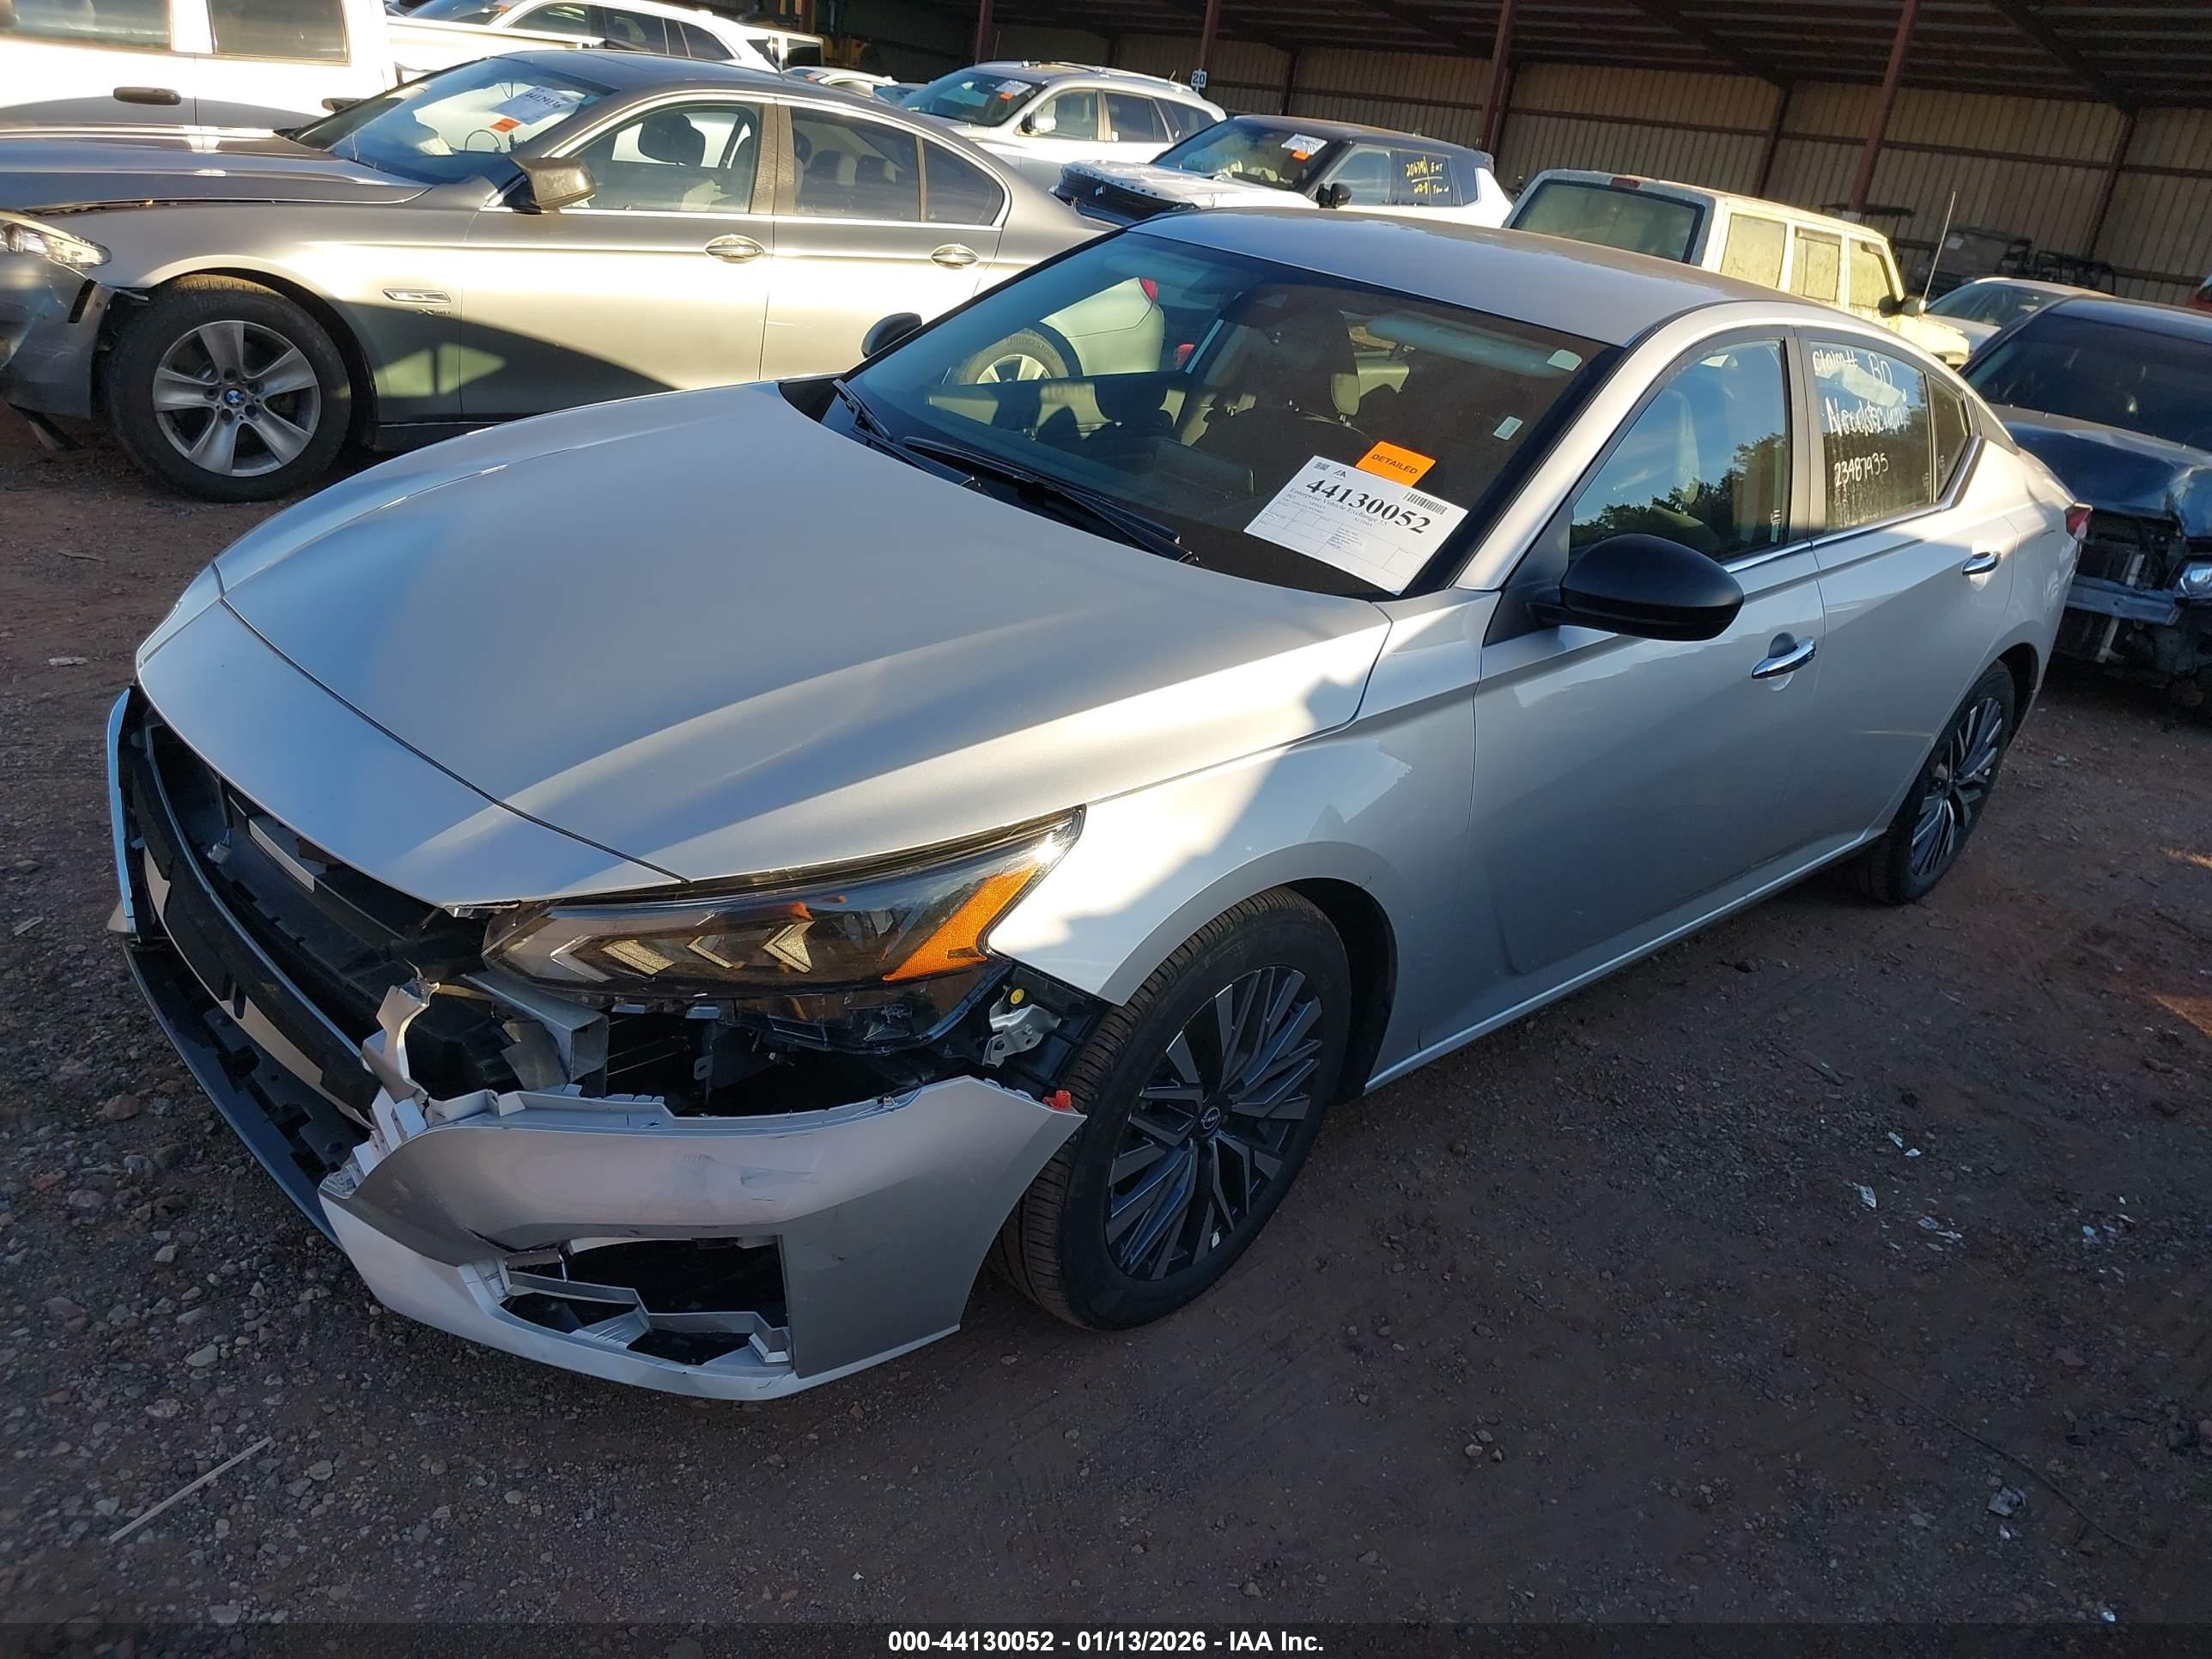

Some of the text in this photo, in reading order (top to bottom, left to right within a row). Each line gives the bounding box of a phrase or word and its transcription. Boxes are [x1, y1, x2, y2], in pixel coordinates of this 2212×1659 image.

[1193, 73, 1206, 85] 20
[1371, 453, 1418, 474] DETAILED
[1834, 452, 1889, 487] 23487935
[1290, 488, 1322, 502] Enterprise
[1323, 499, 1348, 511] Vehicle
[1347, 507, 1377, 523] Exchange
[1306, 479, 1431, 534] 44130052
